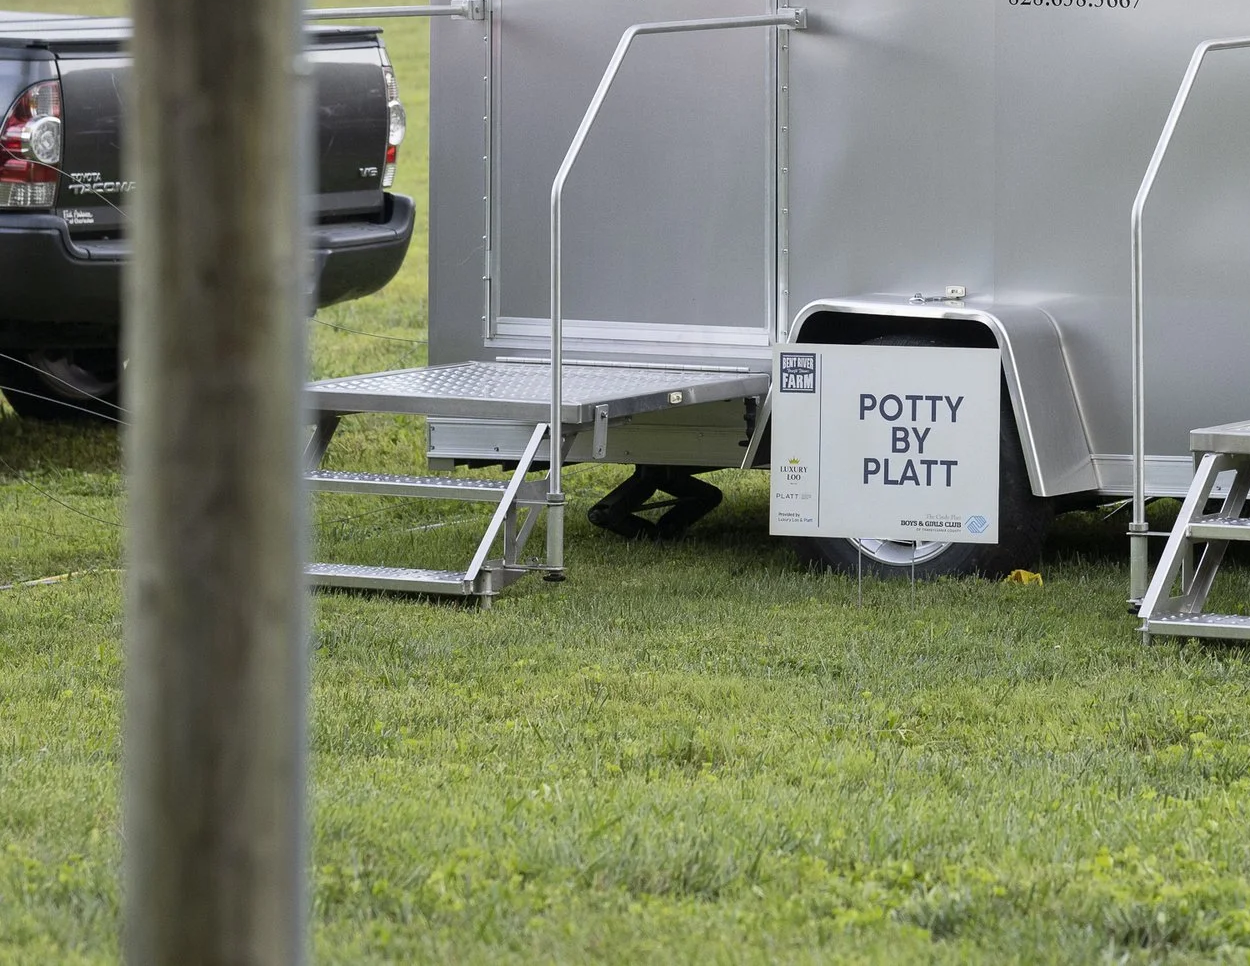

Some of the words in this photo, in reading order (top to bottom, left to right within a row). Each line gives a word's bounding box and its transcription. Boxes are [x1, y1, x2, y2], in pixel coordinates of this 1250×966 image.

[70, 172, 102, 182] TOYOTA
[359, 166, 378, 177] V6
[782, 357, 797, 369] BENT
[782, 373, 814, 389] FARM
[859, 393, 964, 423] POTTY
[891, 426, 931, 454] BY
[863, 457, 958, 487] PLATT
